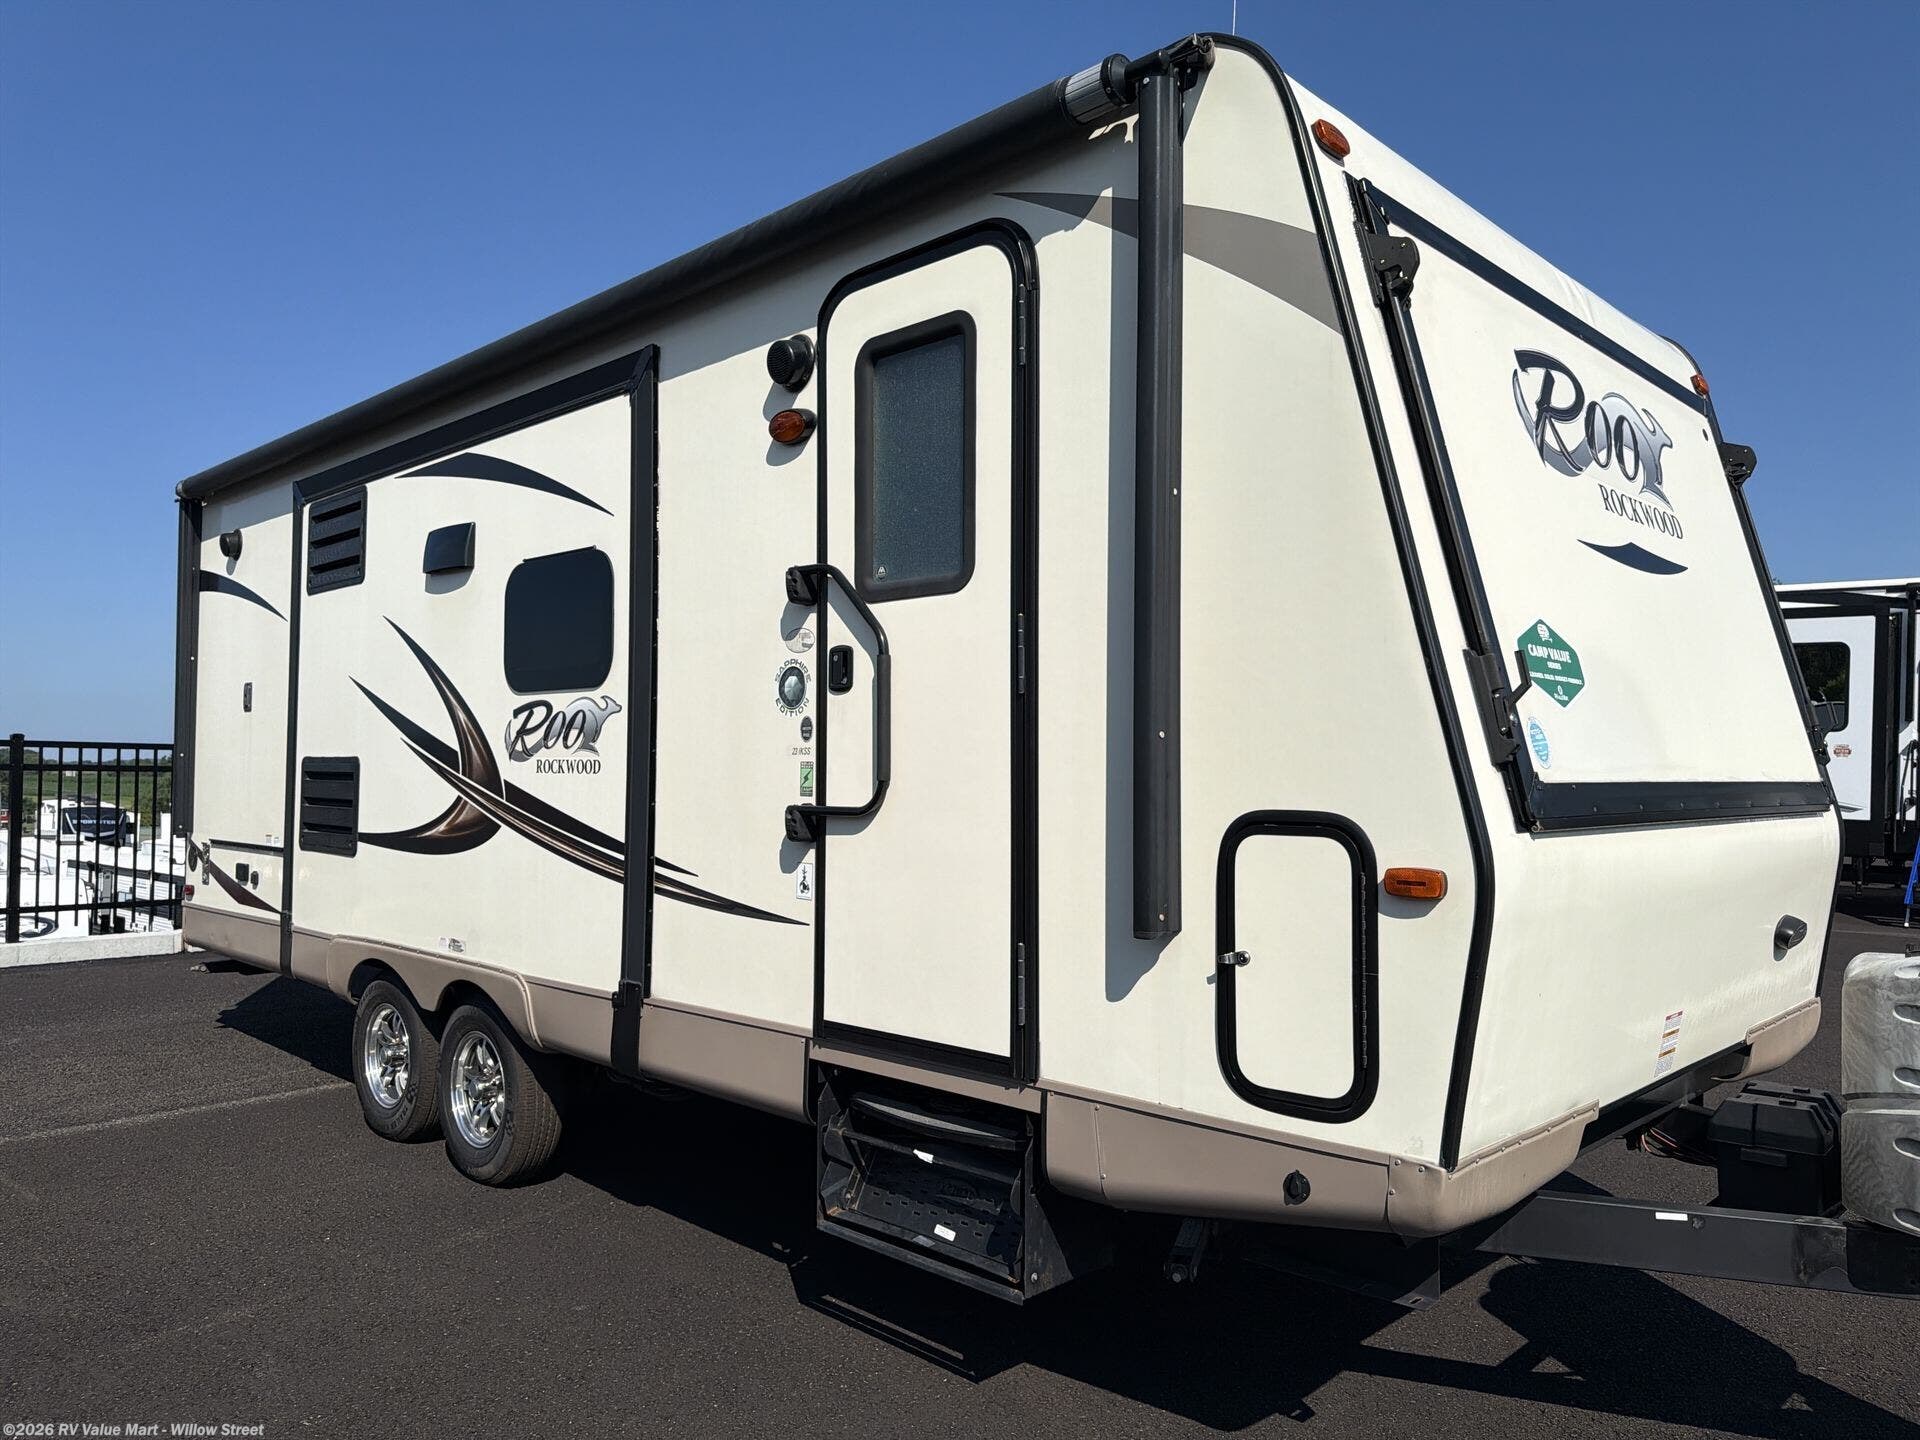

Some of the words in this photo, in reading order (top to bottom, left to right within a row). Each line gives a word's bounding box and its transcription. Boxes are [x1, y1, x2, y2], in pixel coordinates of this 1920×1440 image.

[1598, 483, 1683, 540] ROCKWOOD
[1527, 643, 1548, 659] CAMP
[1548, 647, 1572, 663] VALUE
[775, 658, 812, 684] SAPPHIRE
[775, 697, 810, 717] EDITION
[536, 759, 601, 775] ROCKWOOD
